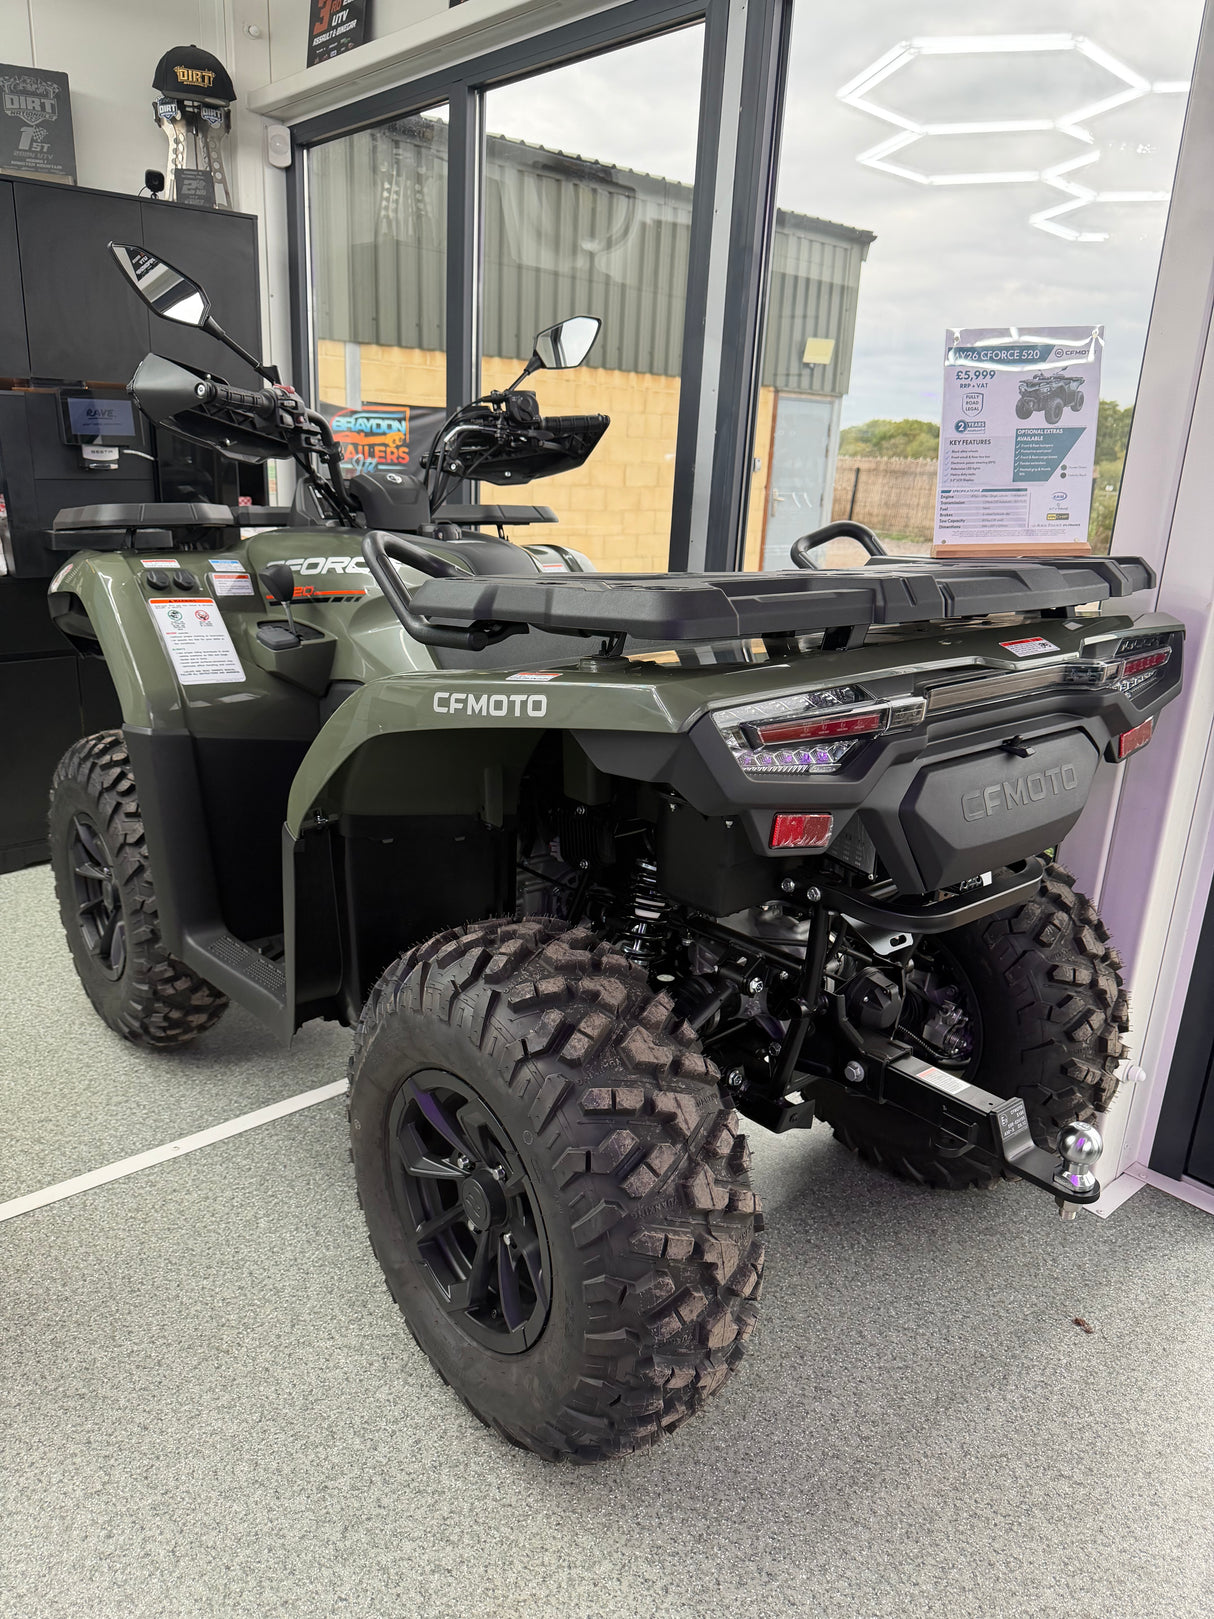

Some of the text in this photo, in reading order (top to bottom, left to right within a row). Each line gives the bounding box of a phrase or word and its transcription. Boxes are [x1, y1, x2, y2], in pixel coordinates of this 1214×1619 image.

[332, 9, 349, 26] UTV
[178, 69, 212, 85] DIRT
[5, 95, 54, 113] DIRT
[160, 104, 177, 112] DIRT
[980, 350, 1020, 360] CFORCE
[1021, 350, 1040, 359] 520
[956, 370, 996, 381] £5,999
[332, 417, 405, 434] BRAYDON
[958, 422, 965, 431] 2
[341, 445, 410, 464] AILERS
[266, 556, 371, 575] FORC
[292, 586, 314, 597] 20
[433, 692, 548, 717] CFMOTO
[961, 764, 1077, 822] CFMOTO
